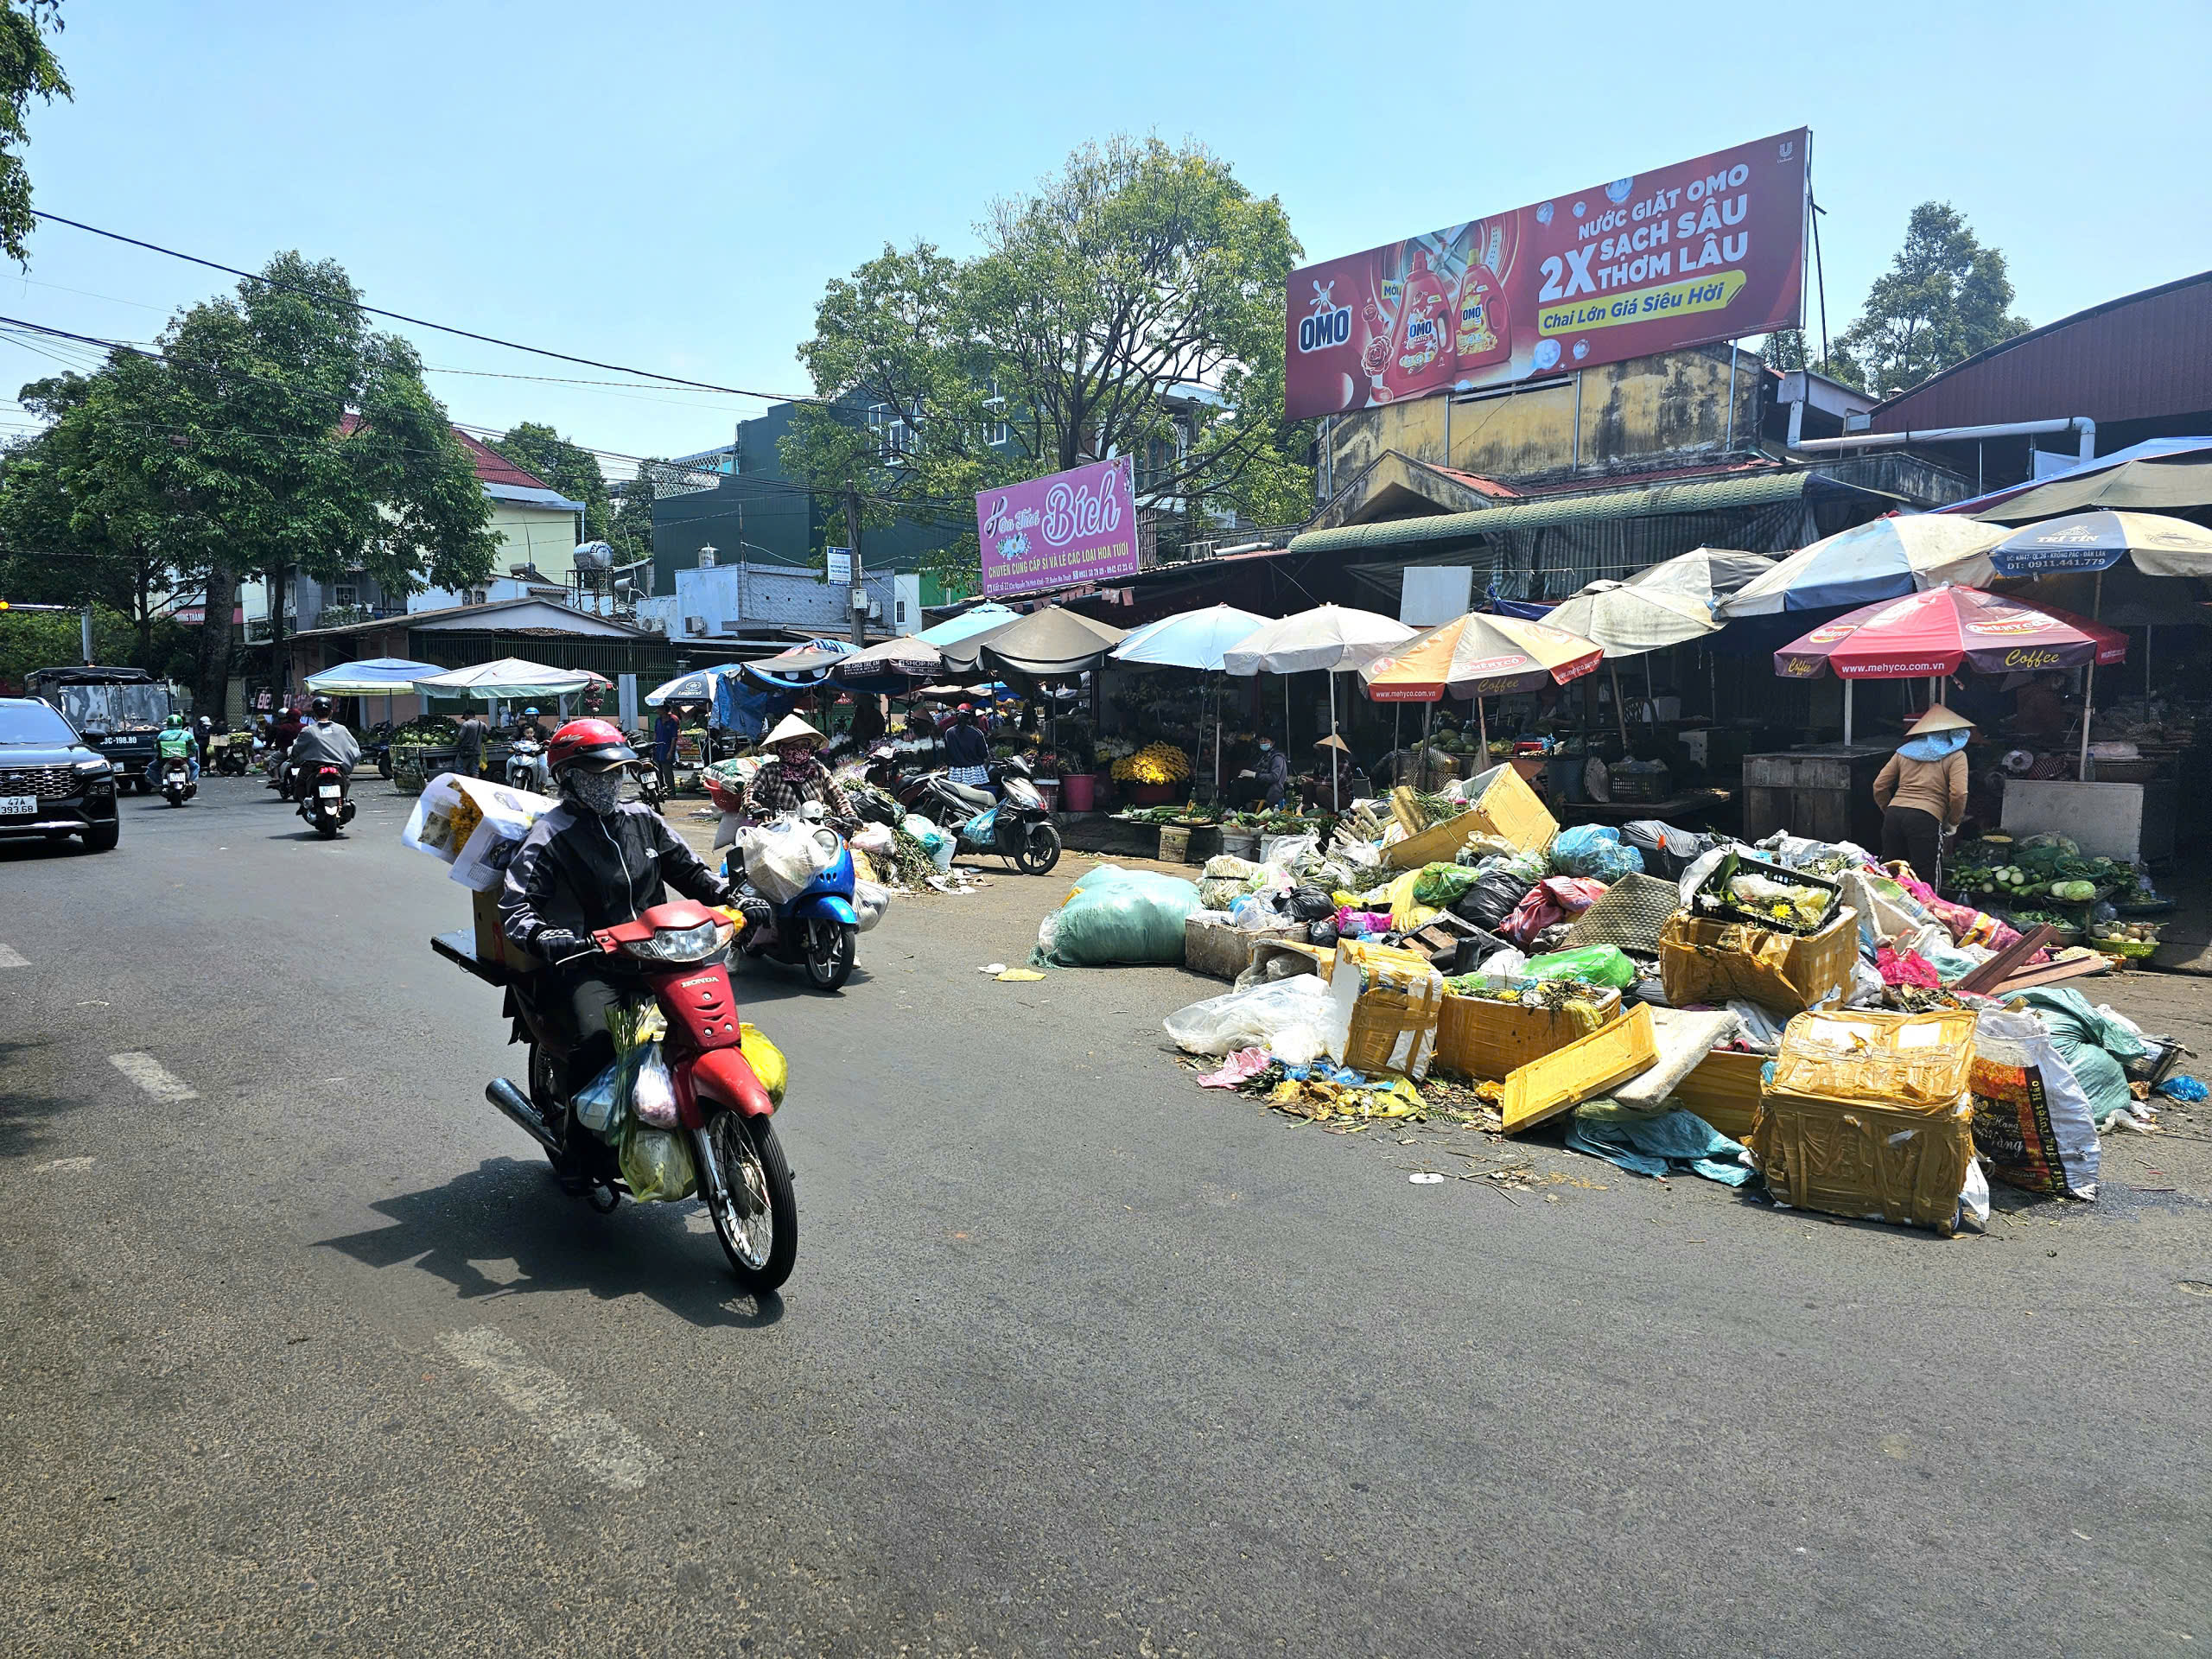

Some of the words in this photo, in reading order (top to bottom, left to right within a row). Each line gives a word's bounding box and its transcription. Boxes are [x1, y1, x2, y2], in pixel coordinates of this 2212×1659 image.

[1578, 210, 1627, 241] NƯỚC
[1631, 188, 1681, 221] GIẶT
[1687, 163, 1749, 202] OMO
[1599, 219, 1669, 261] SẠCH
[1676, 194, 1748, 239] SÂU
[1598, 251, 1671, 290] THƠM
[1679, 232, 1748, 272] LÂU
[1538, 243, 1598, 303] 2X
[1463, 306, 1481, 321] OMO
[1543, 310, 1574, 329] Chai
[1577, 305, 1606, 324] Lớn
[1611, 298, 1637, 318] Giá
[1642, 293, 1683, 313] Siêu
[1688, 282, 1726, 303] Hời
[1300, 309, 1349, 351] OMO
[1409, 321, 1432, 338] OMO
[988, 563, 1011, 579] CHUYÊN
[1012, 562, 1028, 575] CUNG
[1049, 554, 1058, 569] VÀ
[1068, 548, 1080, 566] CÁC
[1098, 545, 1112, 561] HOA
[2028, 558, 2106, 569] 0911.441.779
[1788, 657, 1812, 675] Coffee
[1841, 662, 1945, 673] www.mehyco.com.vn
[2005, 649, 2060, 668] Coffee
[1478, 678, 1520, 693] Coffee
[1, 805, 34, 814] 393.68
[681, 976, 720, 988] HONDA
